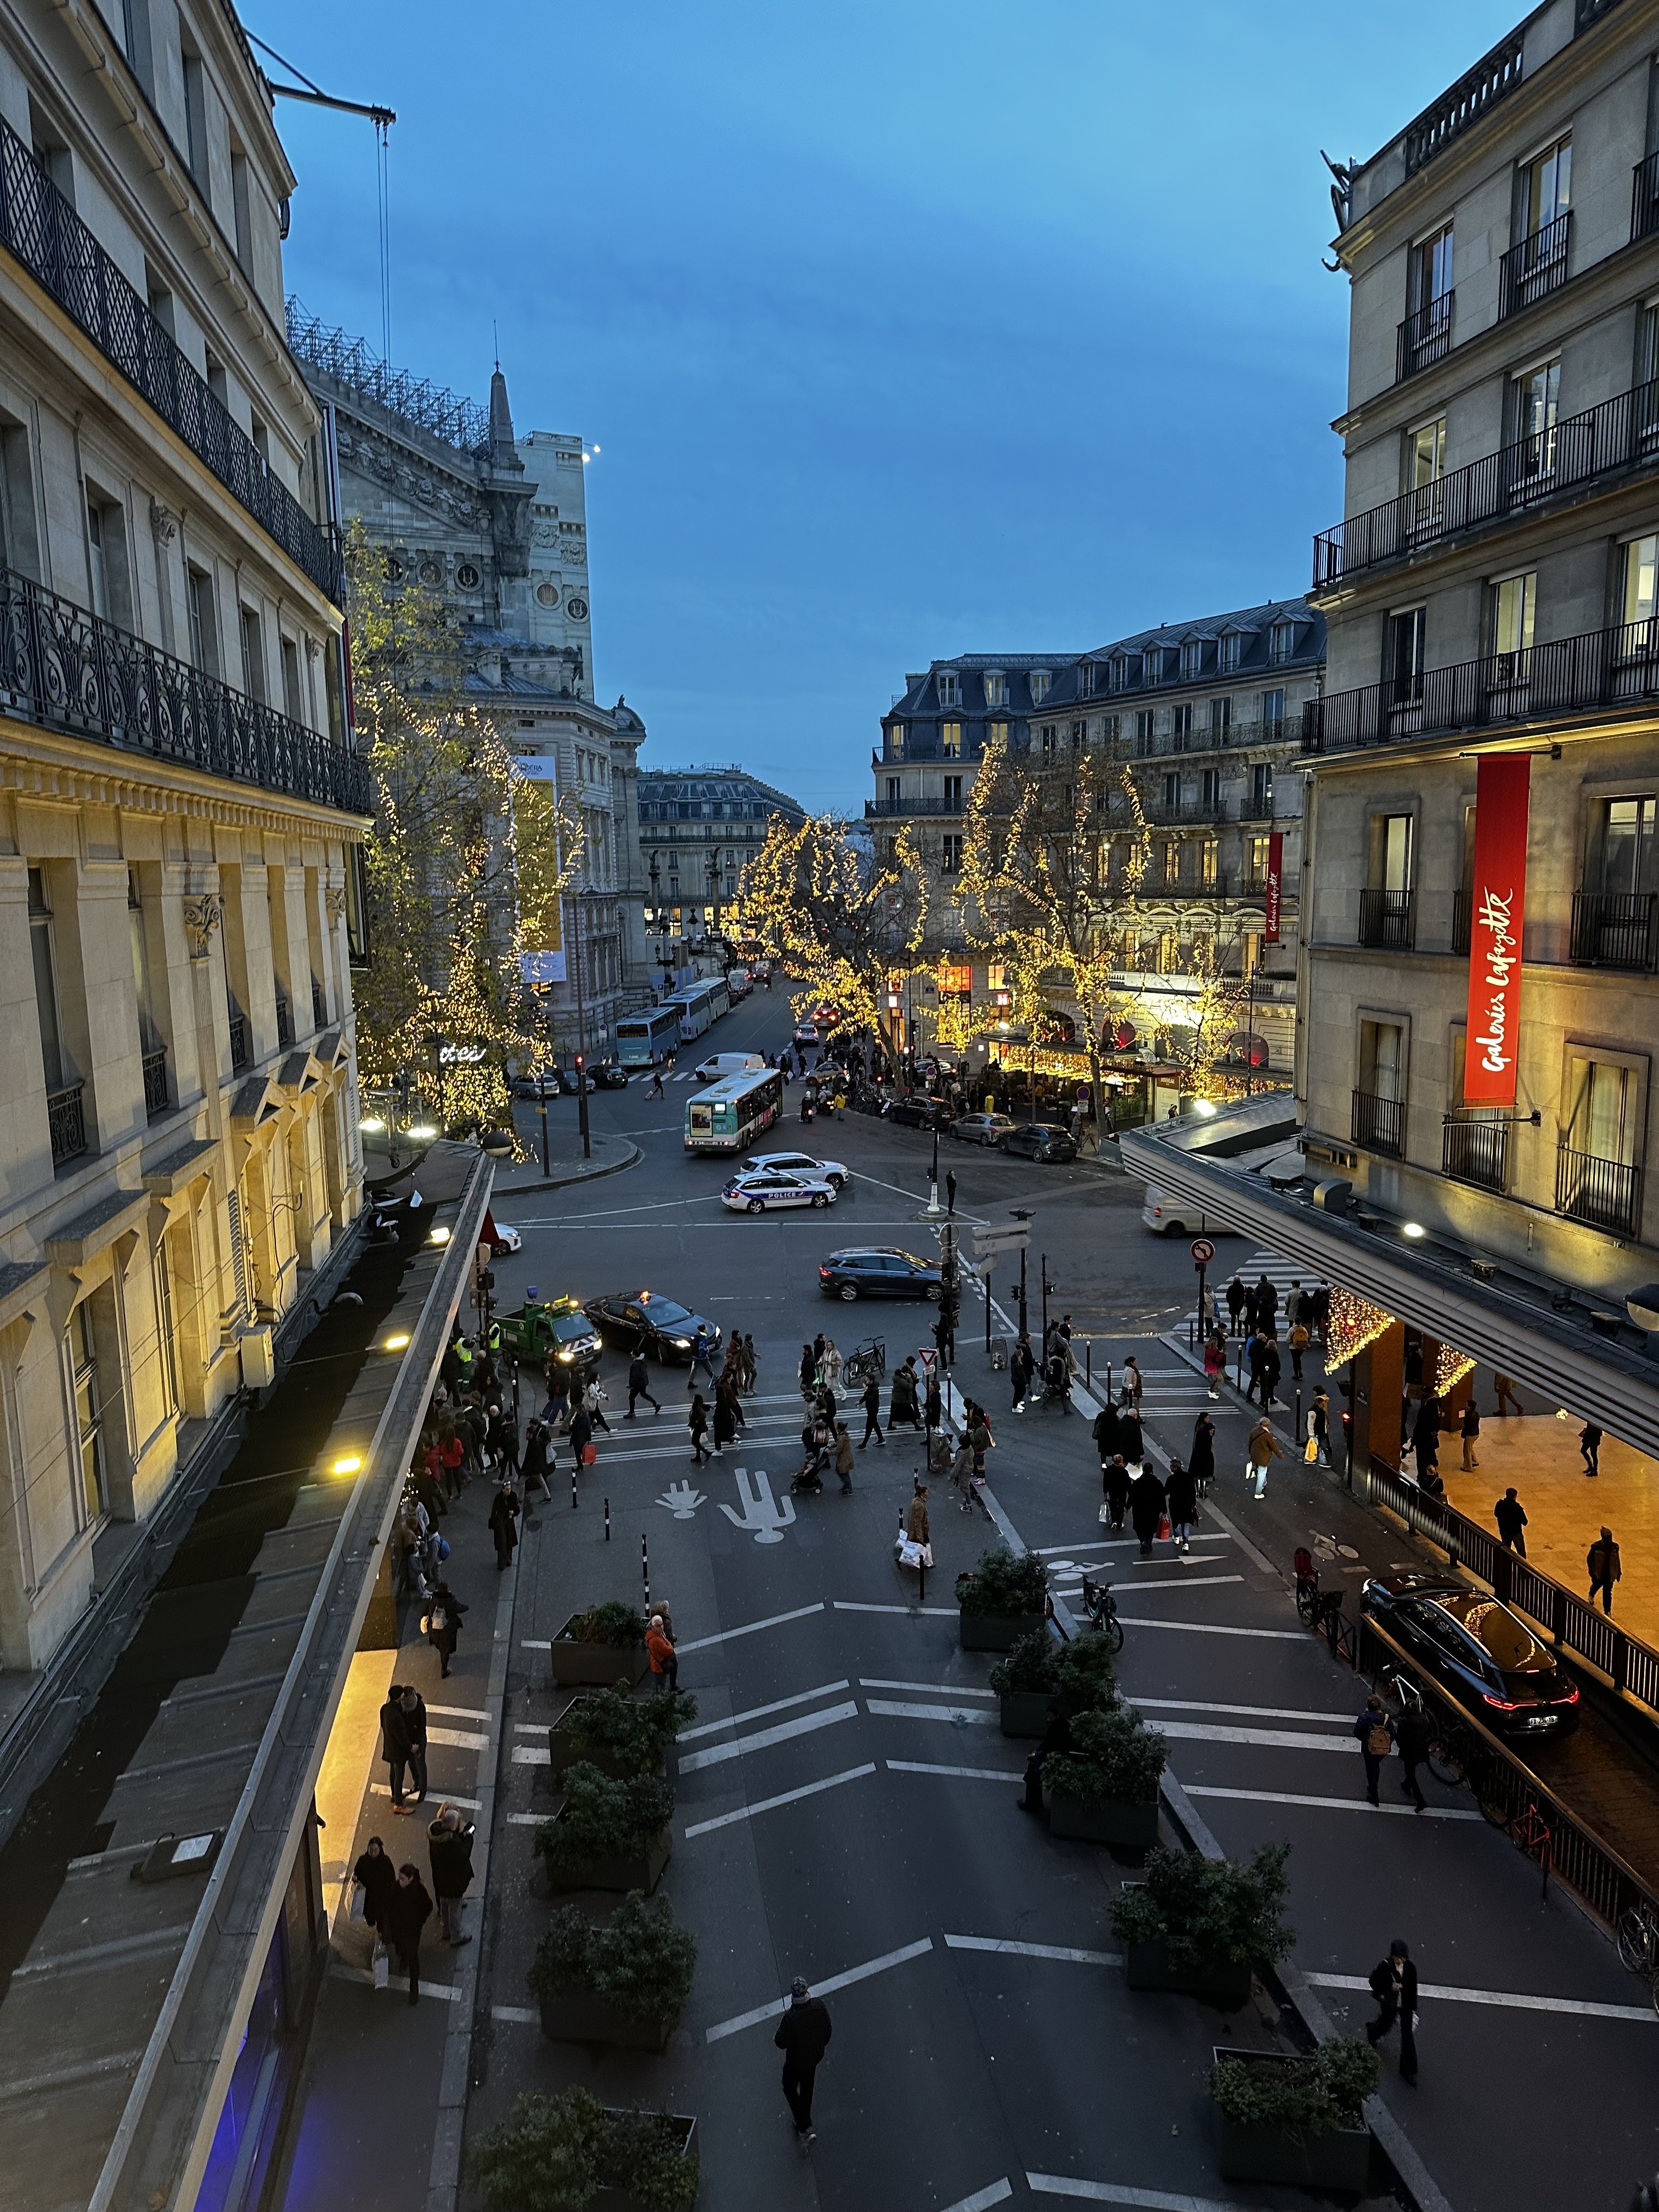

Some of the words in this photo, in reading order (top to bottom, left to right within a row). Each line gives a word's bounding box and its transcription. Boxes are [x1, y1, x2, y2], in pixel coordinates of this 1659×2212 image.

[1269, 871, 1279, 904] Lafayette
[1268, 905, 1278, 932] Galeries
[1479, 885, 1516, 986] Lafayette
[1475, 992, 1511, 1072] Galeries
